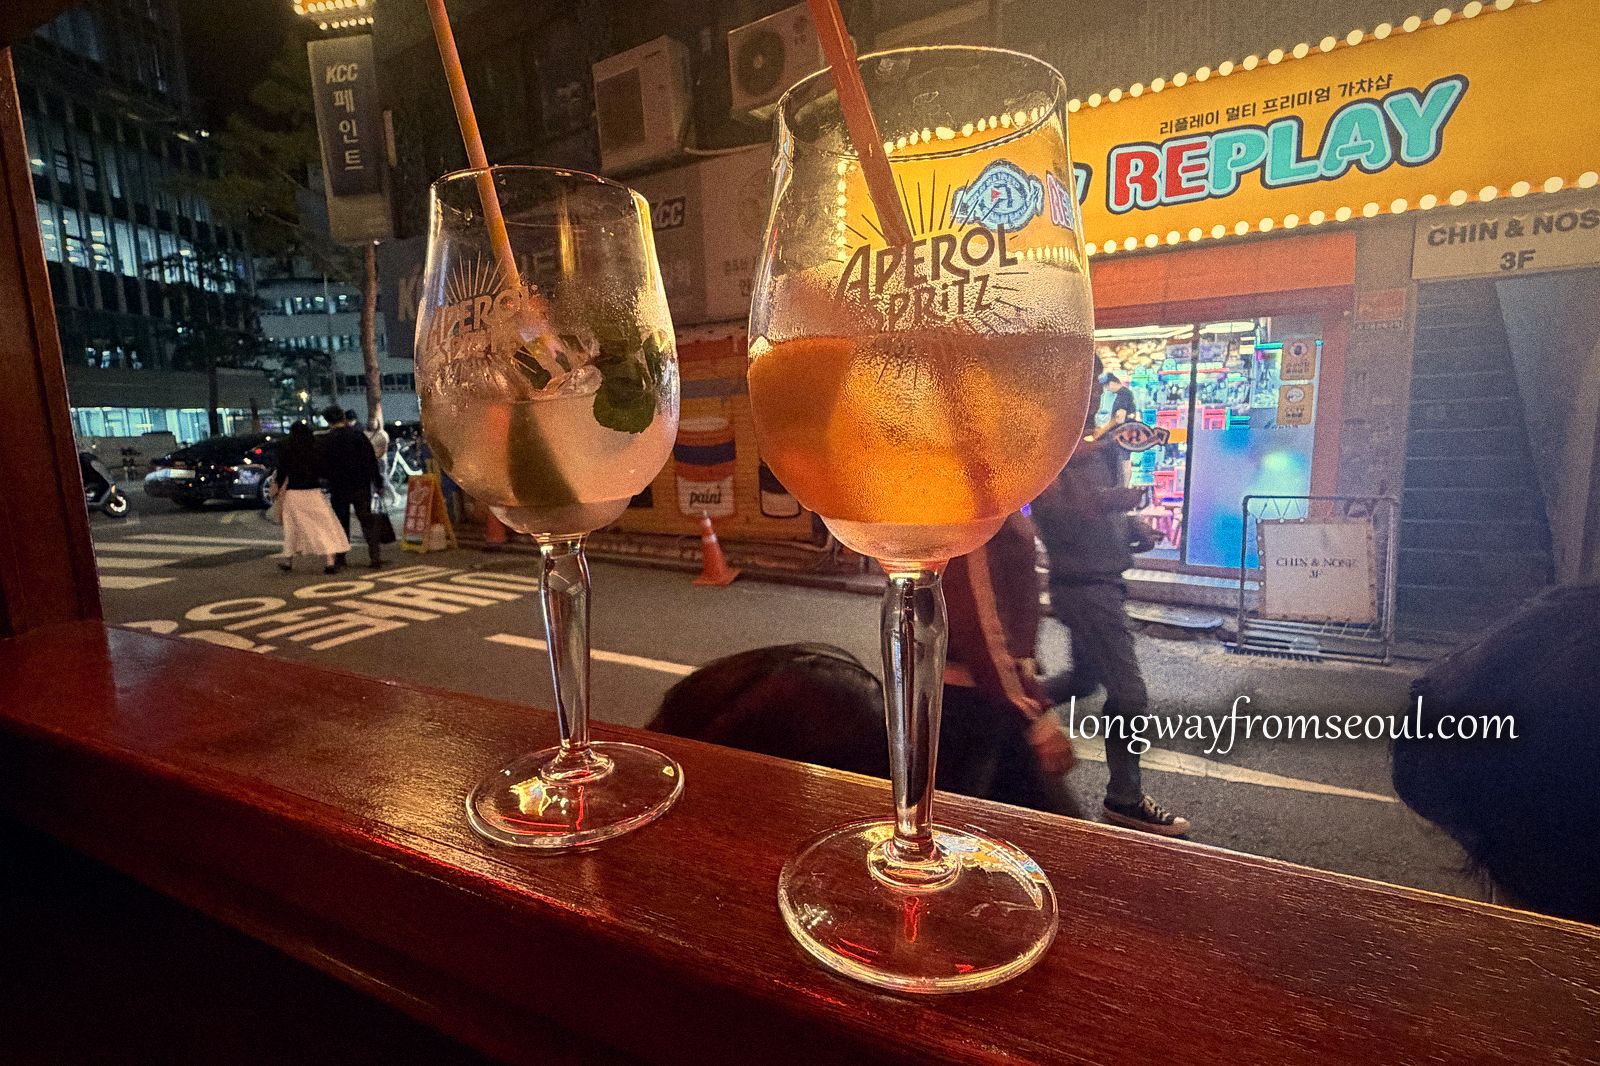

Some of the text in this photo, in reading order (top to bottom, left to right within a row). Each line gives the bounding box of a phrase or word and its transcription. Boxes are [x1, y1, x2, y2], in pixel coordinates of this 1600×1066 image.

[325, 63, 359, 84] KCC
[333, 88, 365, 171] 페인트
[1160, 110, 1220, 134] 리플레이
[1226, 102, 1257, 122] 멀티
[1262, 87, 1331, 115] 프리미엄
[1107, 75, 1469, 214] REPLAY
[1428, 220, 1499, 247] CHIN
[1505, 218, 1524, 238] &
[836, 224, 1019, 304] APEROL
[1500, 248, 1536, 271] 3F
[688, 485, 723, 508] paint
[121, 565, 541, 652] 일방통
